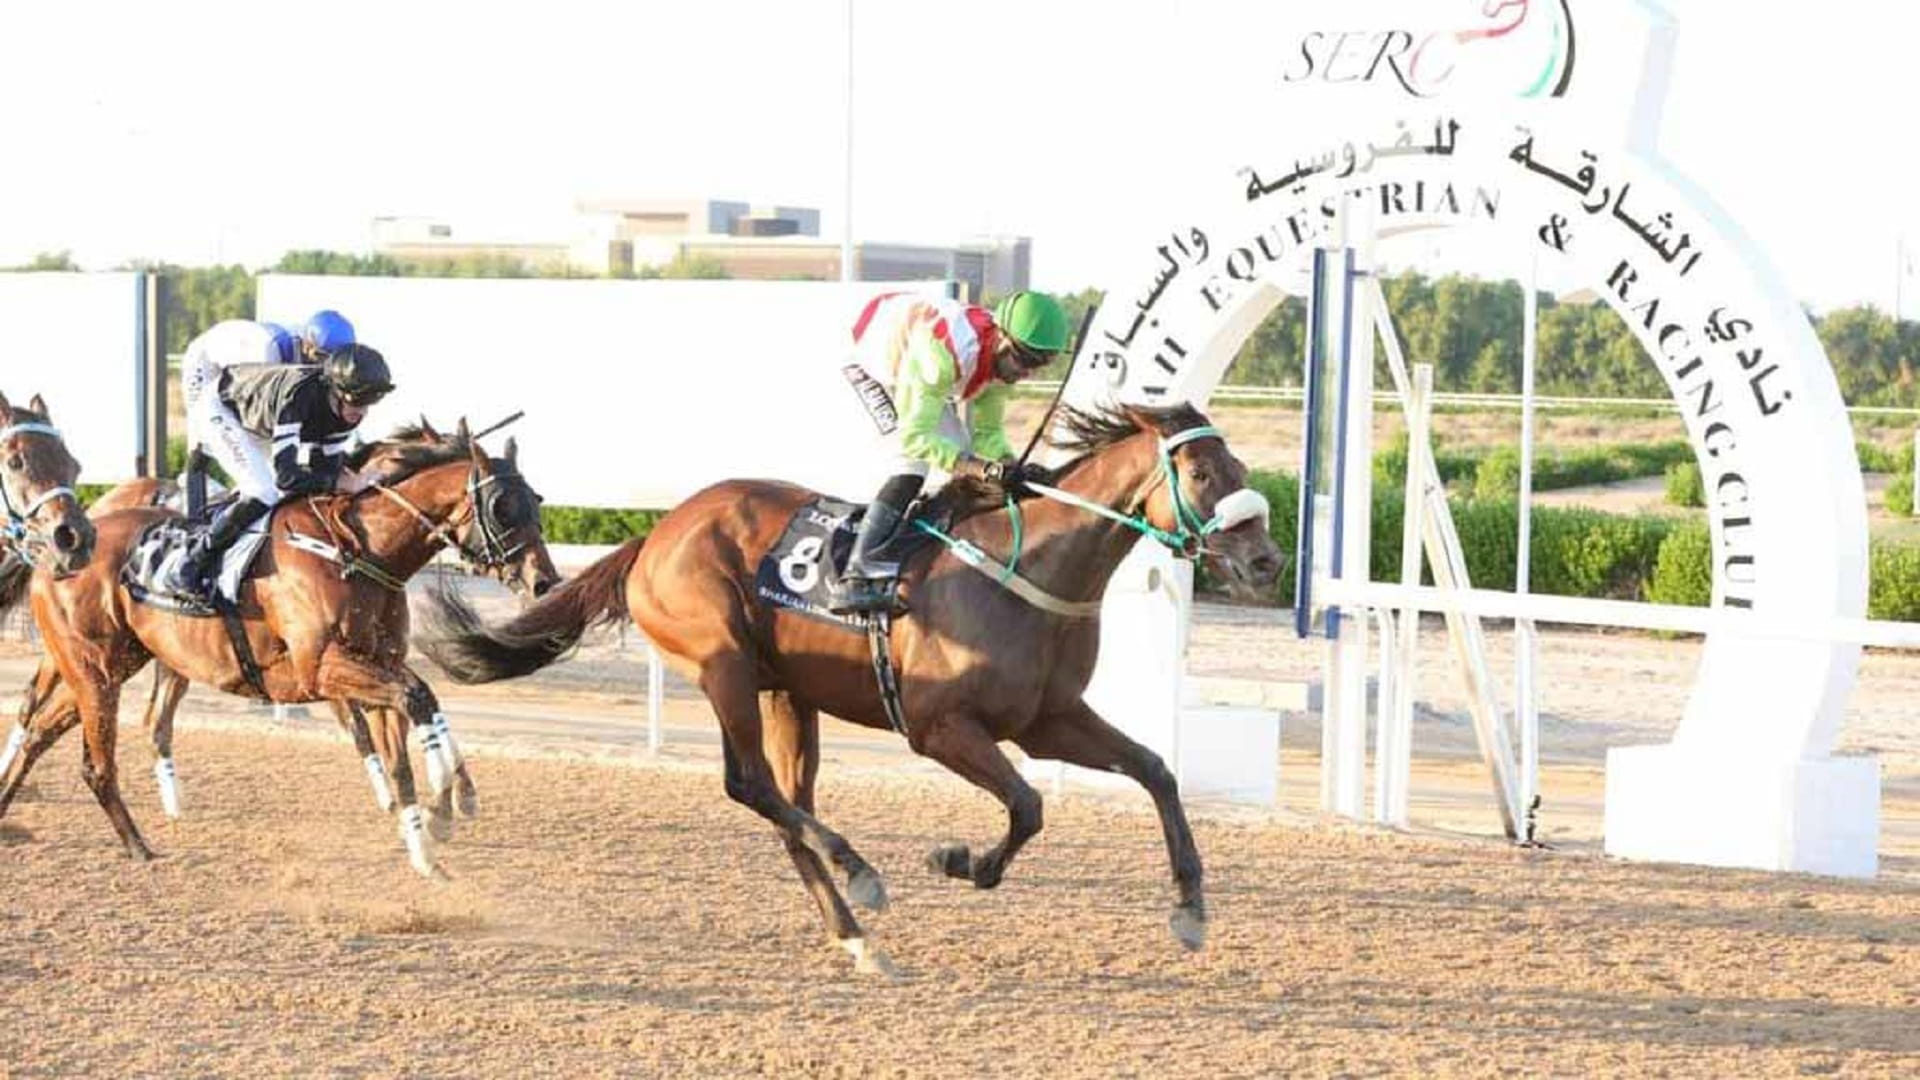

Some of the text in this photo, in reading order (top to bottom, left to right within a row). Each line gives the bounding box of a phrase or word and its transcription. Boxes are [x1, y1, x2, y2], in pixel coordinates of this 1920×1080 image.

[1283, 29, 1457, 99] SERC
[1236, 114, 1462, 202] للفروسية
[1509, 124, 1703, 277] الشارقة
[1088, 226, 1209, 390] والسباق
[1537, 212, 1574, 254] &
[1605, 258, 1737, 457] RACING
[1704, 305, 1793, 416] نادي
[779, 536, 824, 594] 8
